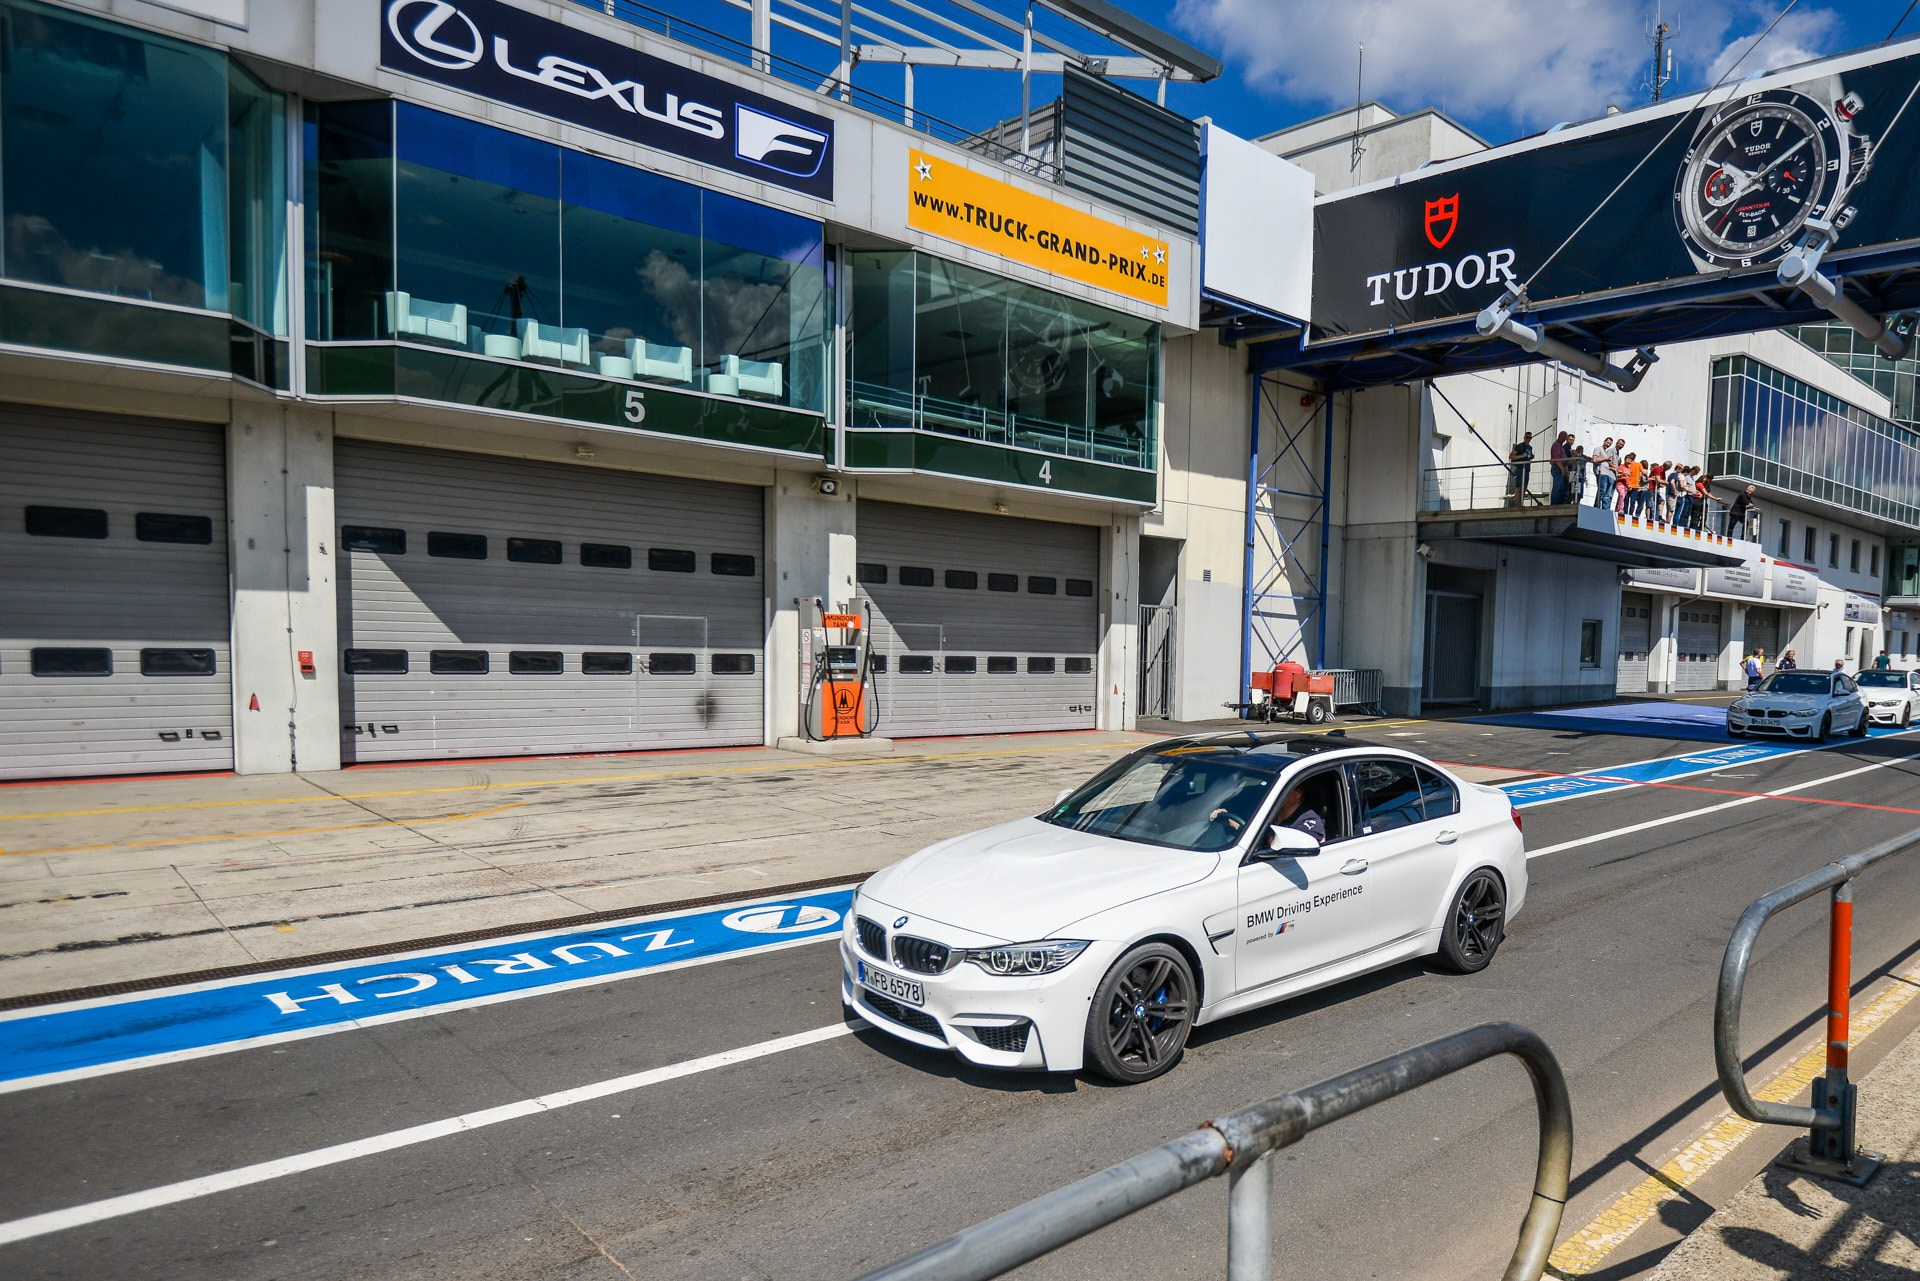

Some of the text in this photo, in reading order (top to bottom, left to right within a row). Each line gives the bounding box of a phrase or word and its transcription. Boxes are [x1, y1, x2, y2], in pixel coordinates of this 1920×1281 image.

[494, 36, 725, 140] LEXUS
[1746, 93, 1762, 106] 12
[1817, 117, 1831, 131] 2
[1744, 142, 1771, 153] TUDOR
[1826, 159, 1839, 171] 3
[913, 190, 1165, 288] www.TRUCK-GRAND-PRIX.DE
[1780, 240, 1794, 252] 5
[1741, 258, 1752, 268] 6
[1366, 248, 1518, 307] TUDOR
[624, 390, 646, 423] 5
[1039, 460, 1052, 485] 4
[825, 614, 857, 622] MUNDORF
[1247, 885, 1363, 928] BMW Driving Experience
[1246, 933, 1267, 946] powered
[261, 928, 696, 1015] ZURICH
[874, 971, 888, 991] FB
[890, 978, 920, 1002] 6578
